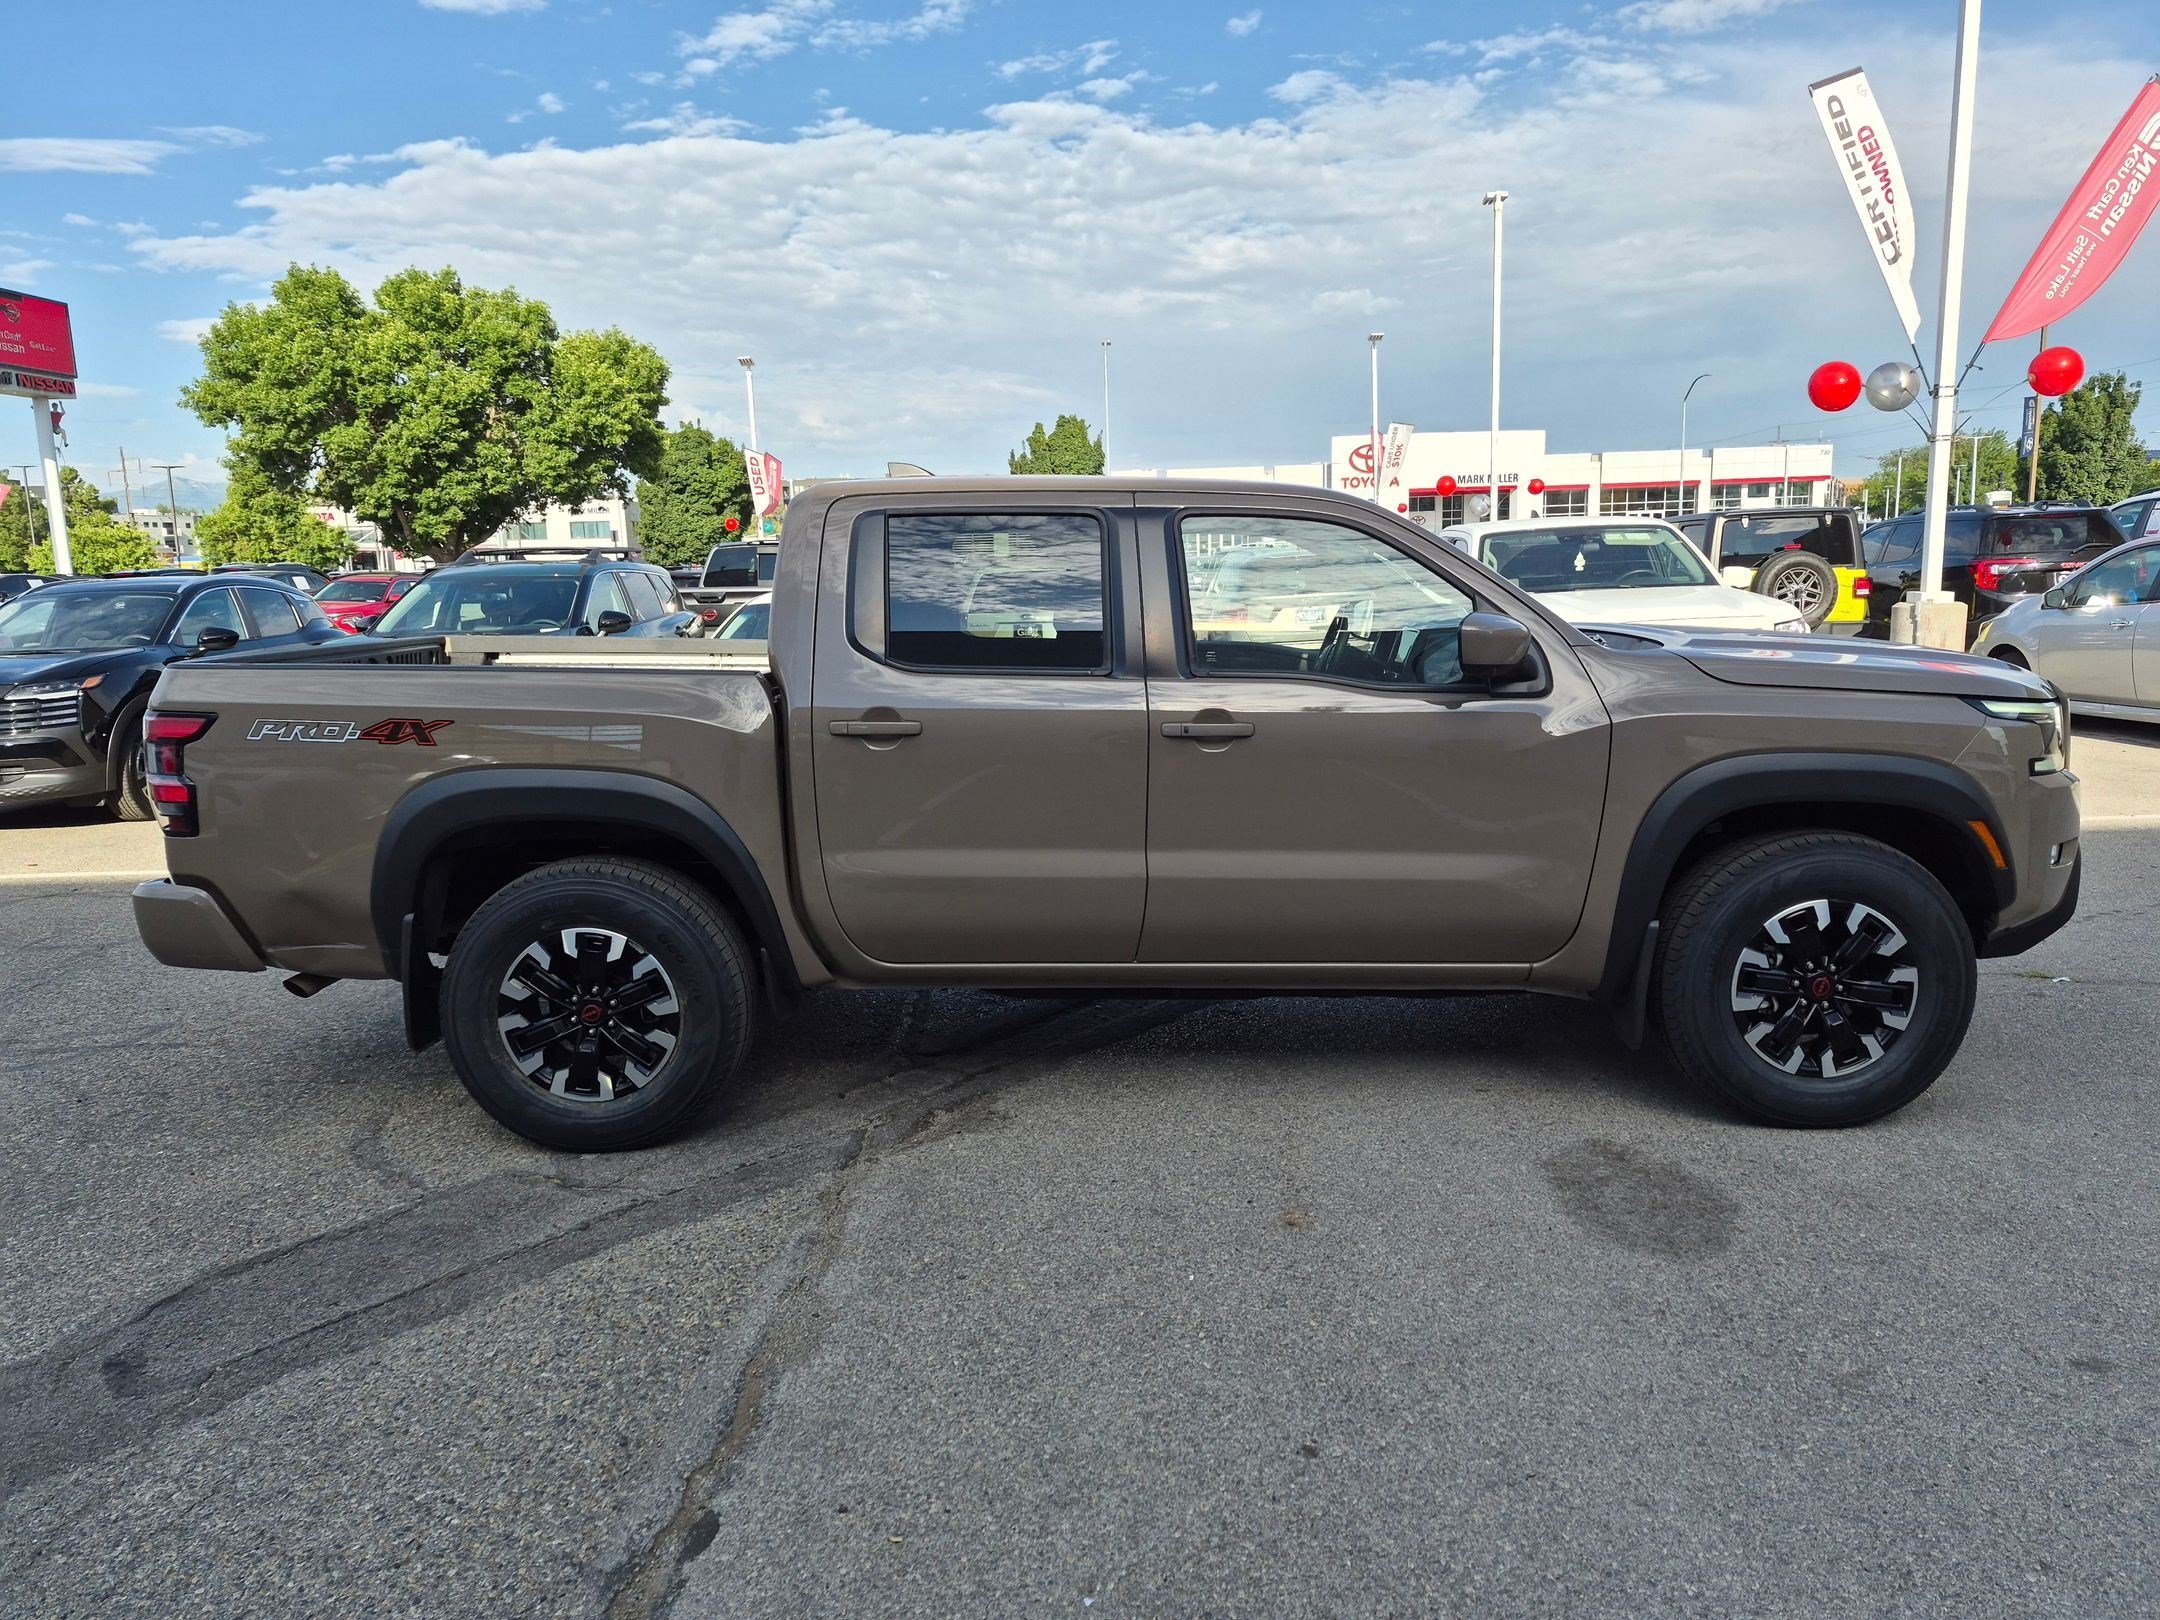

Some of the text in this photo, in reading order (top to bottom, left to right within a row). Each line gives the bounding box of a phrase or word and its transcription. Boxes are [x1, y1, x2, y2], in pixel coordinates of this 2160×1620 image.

[1827, 94, 1902, 266] CERTIFIED
[0, 342, 25, 354] issan
[17, 373, 76, 394] NISSAN
[749, 456, 766, 496] USED
[1340, 476, 1400, 489] TOYOA
[1457, 473, 1519, 484] MARK LLER
